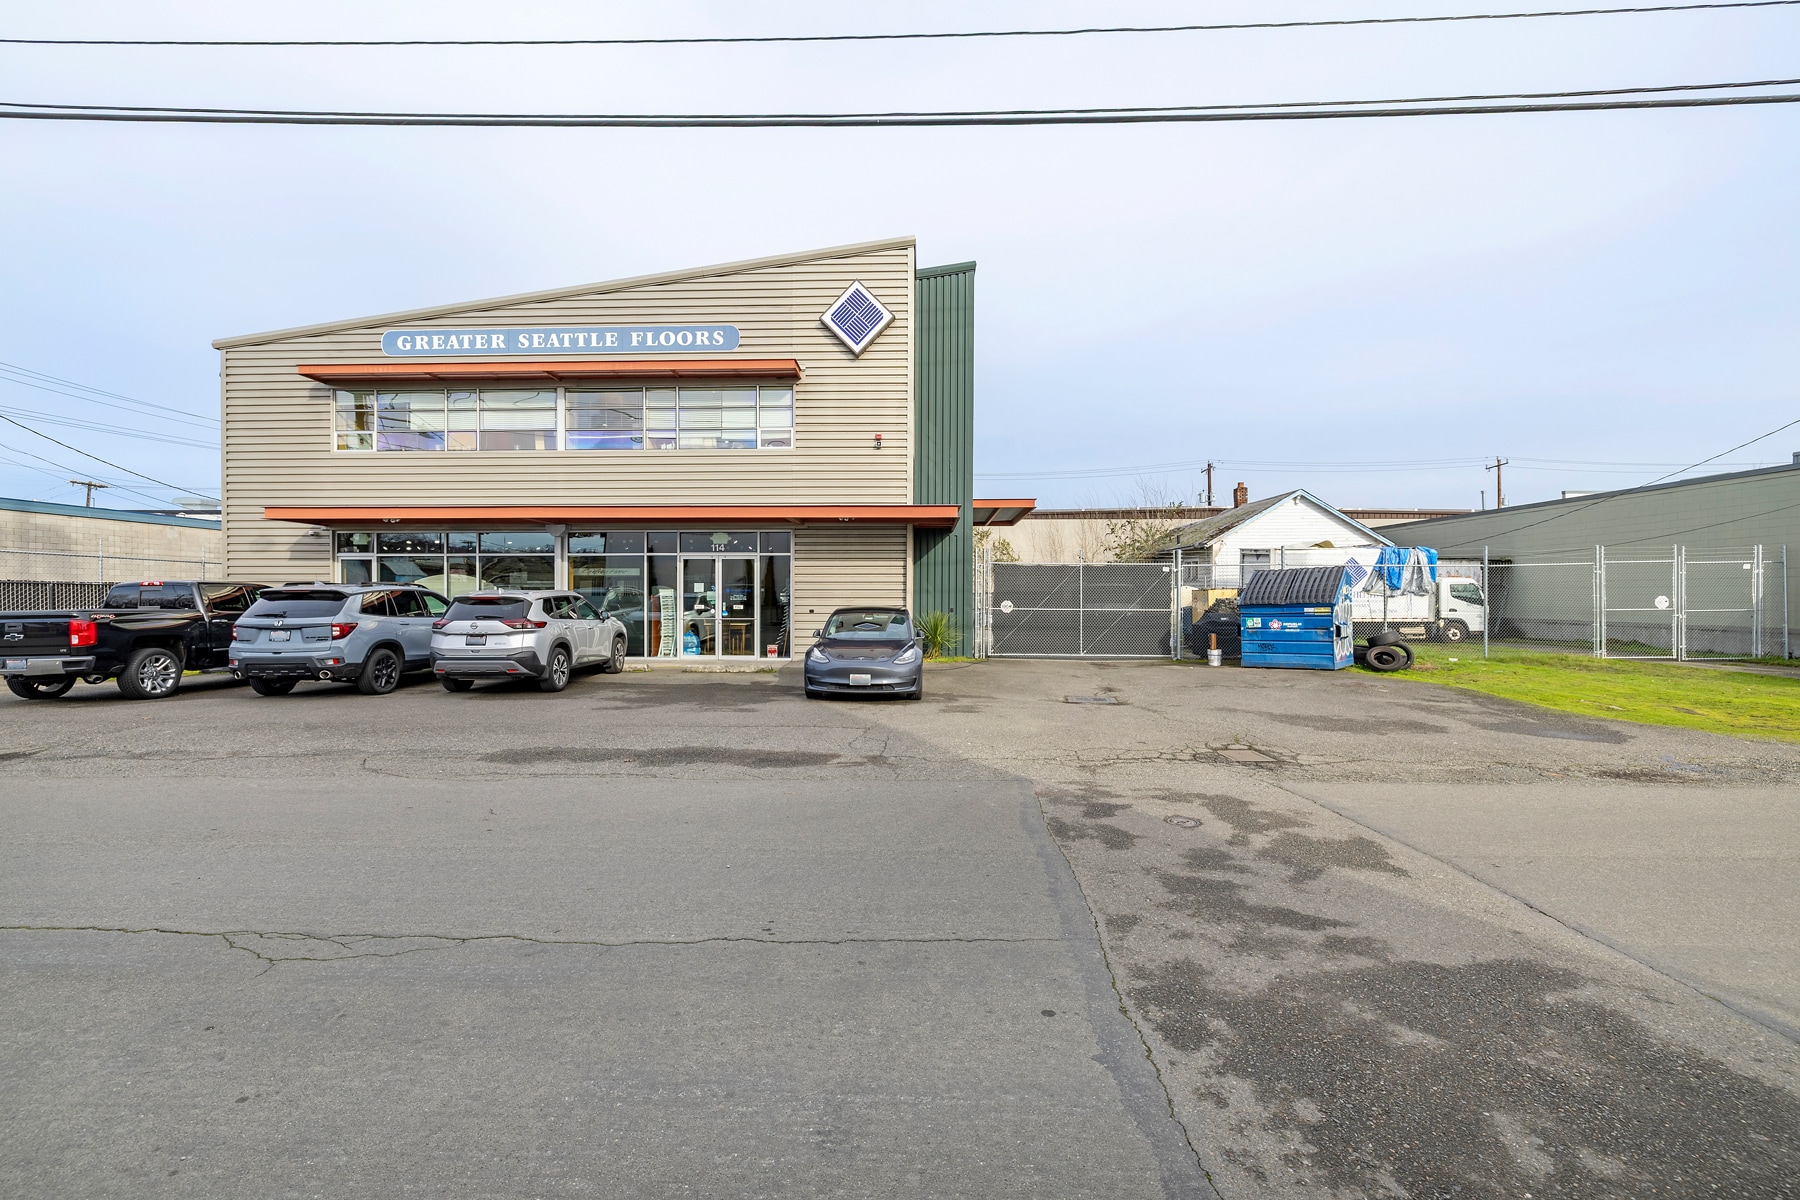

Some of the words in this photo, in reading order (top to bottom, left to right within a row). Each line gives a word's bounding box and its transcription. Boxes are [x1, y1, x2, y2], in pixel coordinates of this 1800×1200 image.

[397, 334, 506, 350] GREATER
[517, 332, 618, 348] SEATTLE
[630, 330, 724, 346] FLOORS
[711, 543, 725, 552] 114
